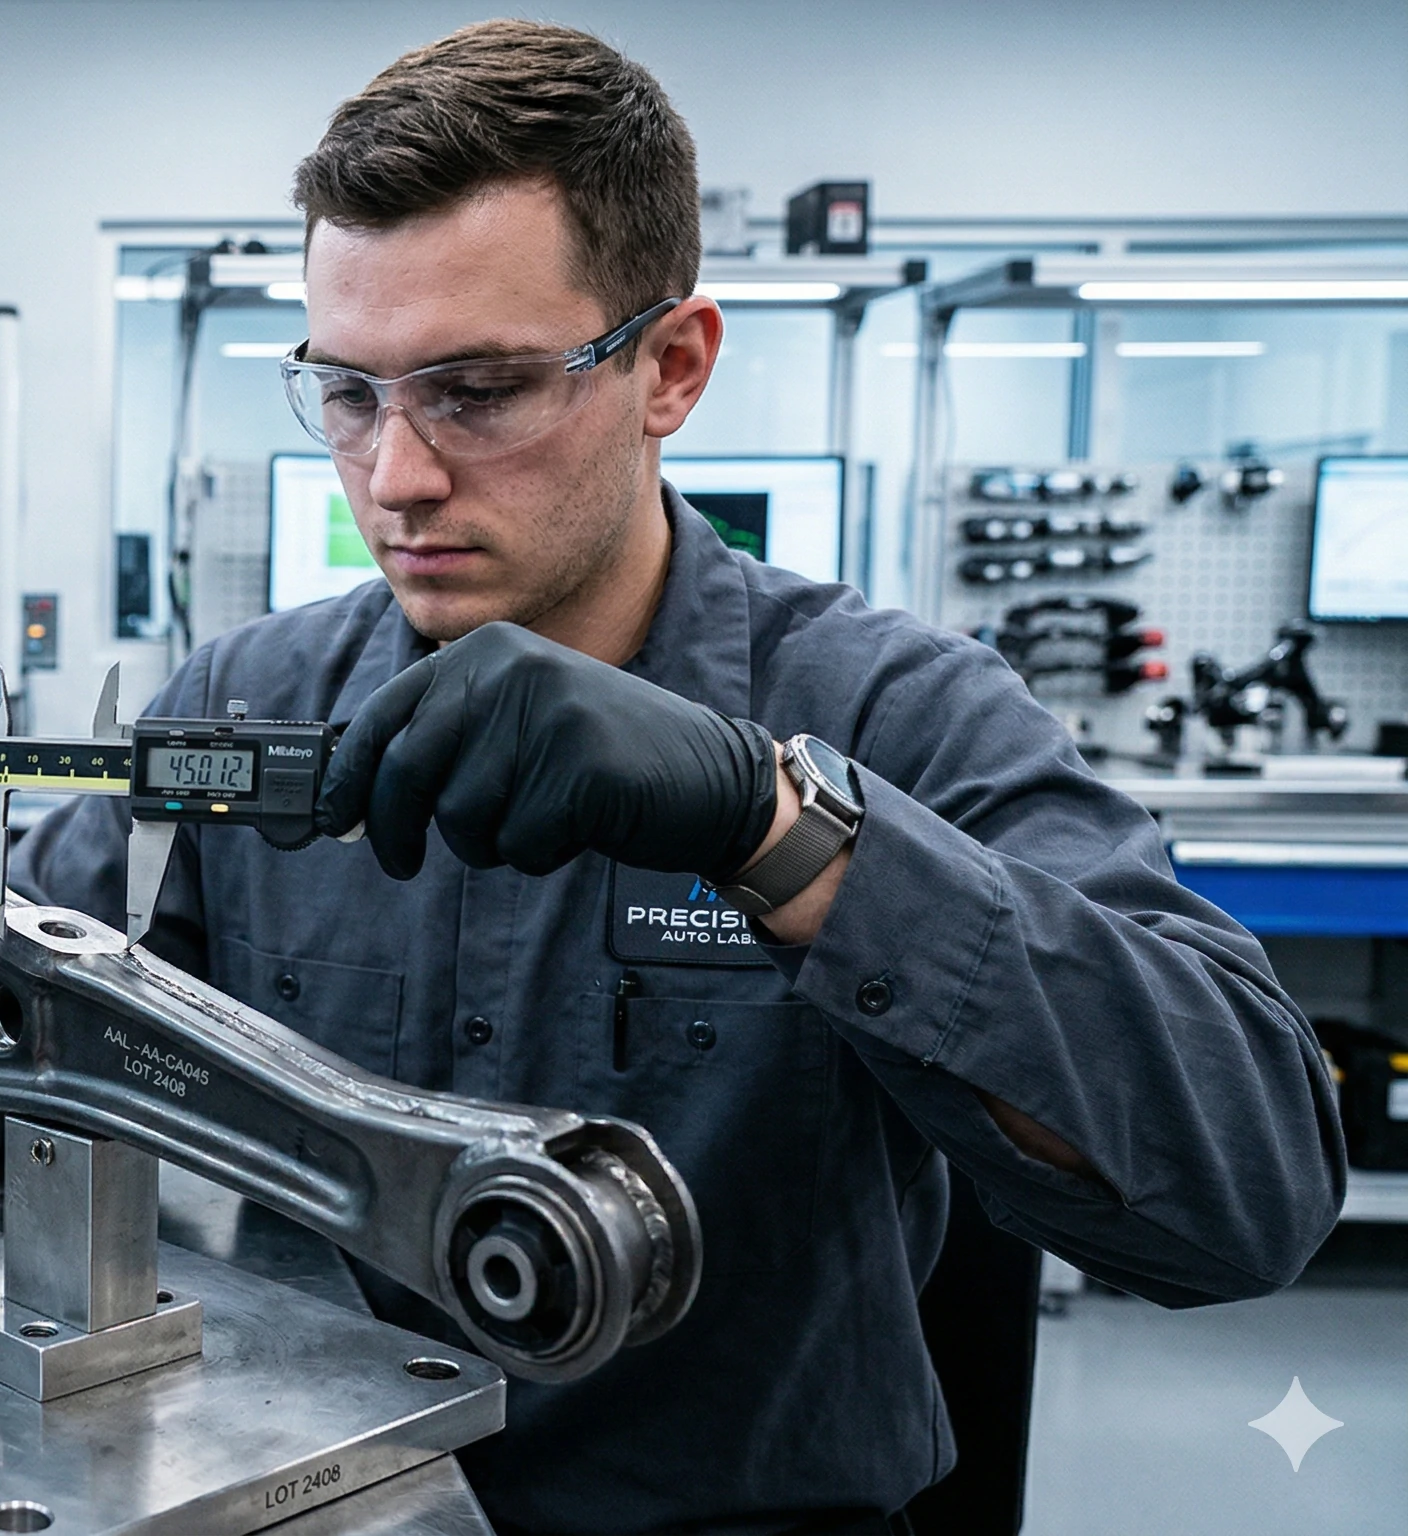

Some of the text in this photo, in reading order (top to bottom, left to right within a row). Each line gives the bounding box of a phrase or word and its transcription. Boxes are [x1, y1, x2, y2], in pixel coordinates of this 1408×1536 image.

[661, 930, 711, 944] AUTO
[103, 1026, 130, 1050] AAL
[123, 1055, 152, 1080] LOT
[265, 1464, 341, 1510] LOT 2408
